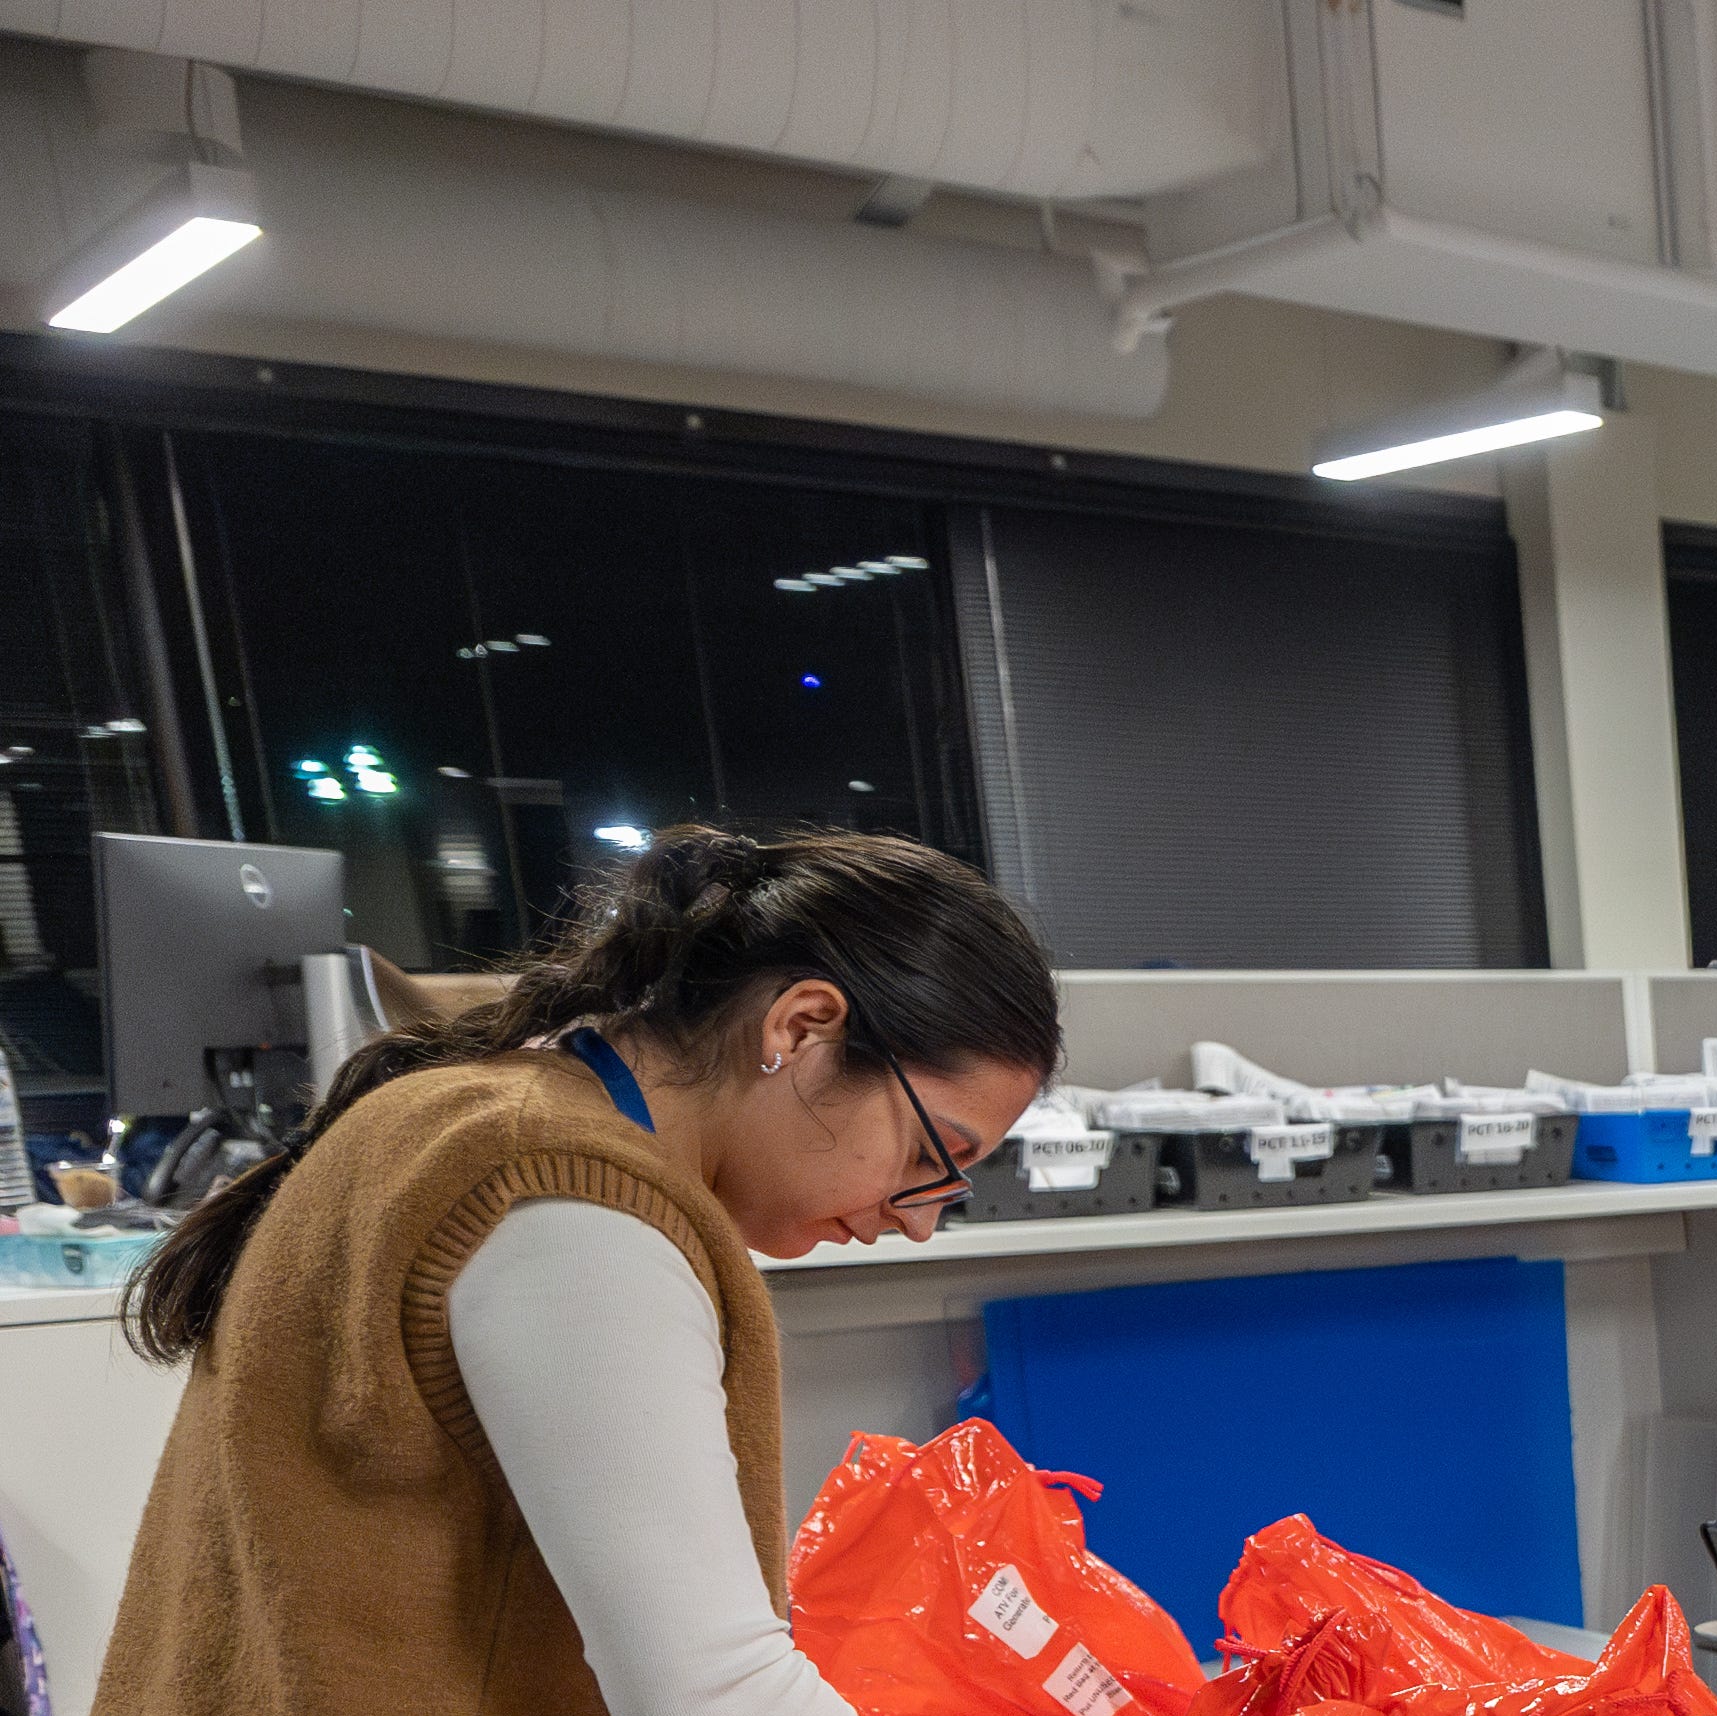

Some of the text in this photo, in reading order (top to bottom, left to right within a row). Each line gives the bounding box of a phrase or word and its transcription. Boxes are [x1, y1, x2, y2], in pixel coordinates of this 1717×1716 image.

[1695, 1113, 1717, 1125] PCT
[1467, 1122, 1492, 1136] PCT
[1032, 1141, 1061, 1154] PCT
[1258, 1136, 1286, 1150] PCT
[994, 1599, 1009, 1619] ATV
[1002, 1596, 1031, 1631] Generate
